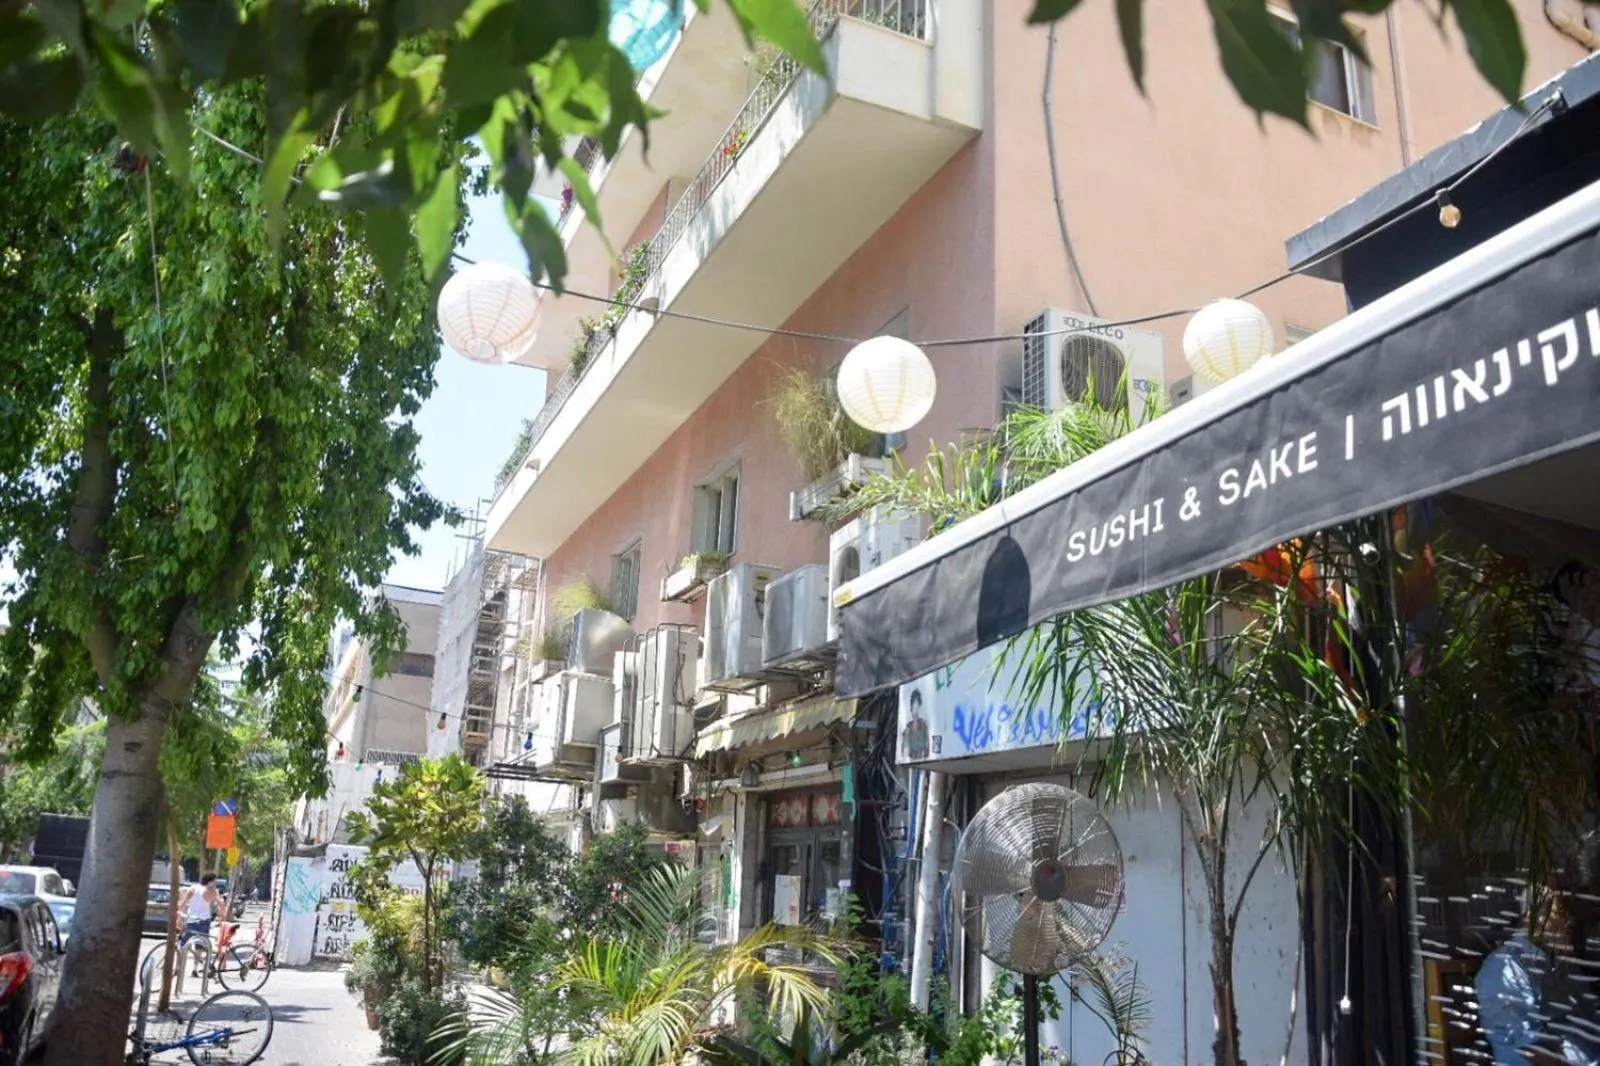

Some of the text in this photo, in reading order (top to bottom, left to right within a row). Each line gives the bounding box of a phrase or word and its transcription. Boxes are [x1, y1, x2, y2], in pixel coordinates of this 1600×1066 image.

[1066, 498, 1165, 563] SUSHI
[1179, 486, 1201, 522] &
[1218, 431, 1319, 506] SAKE
